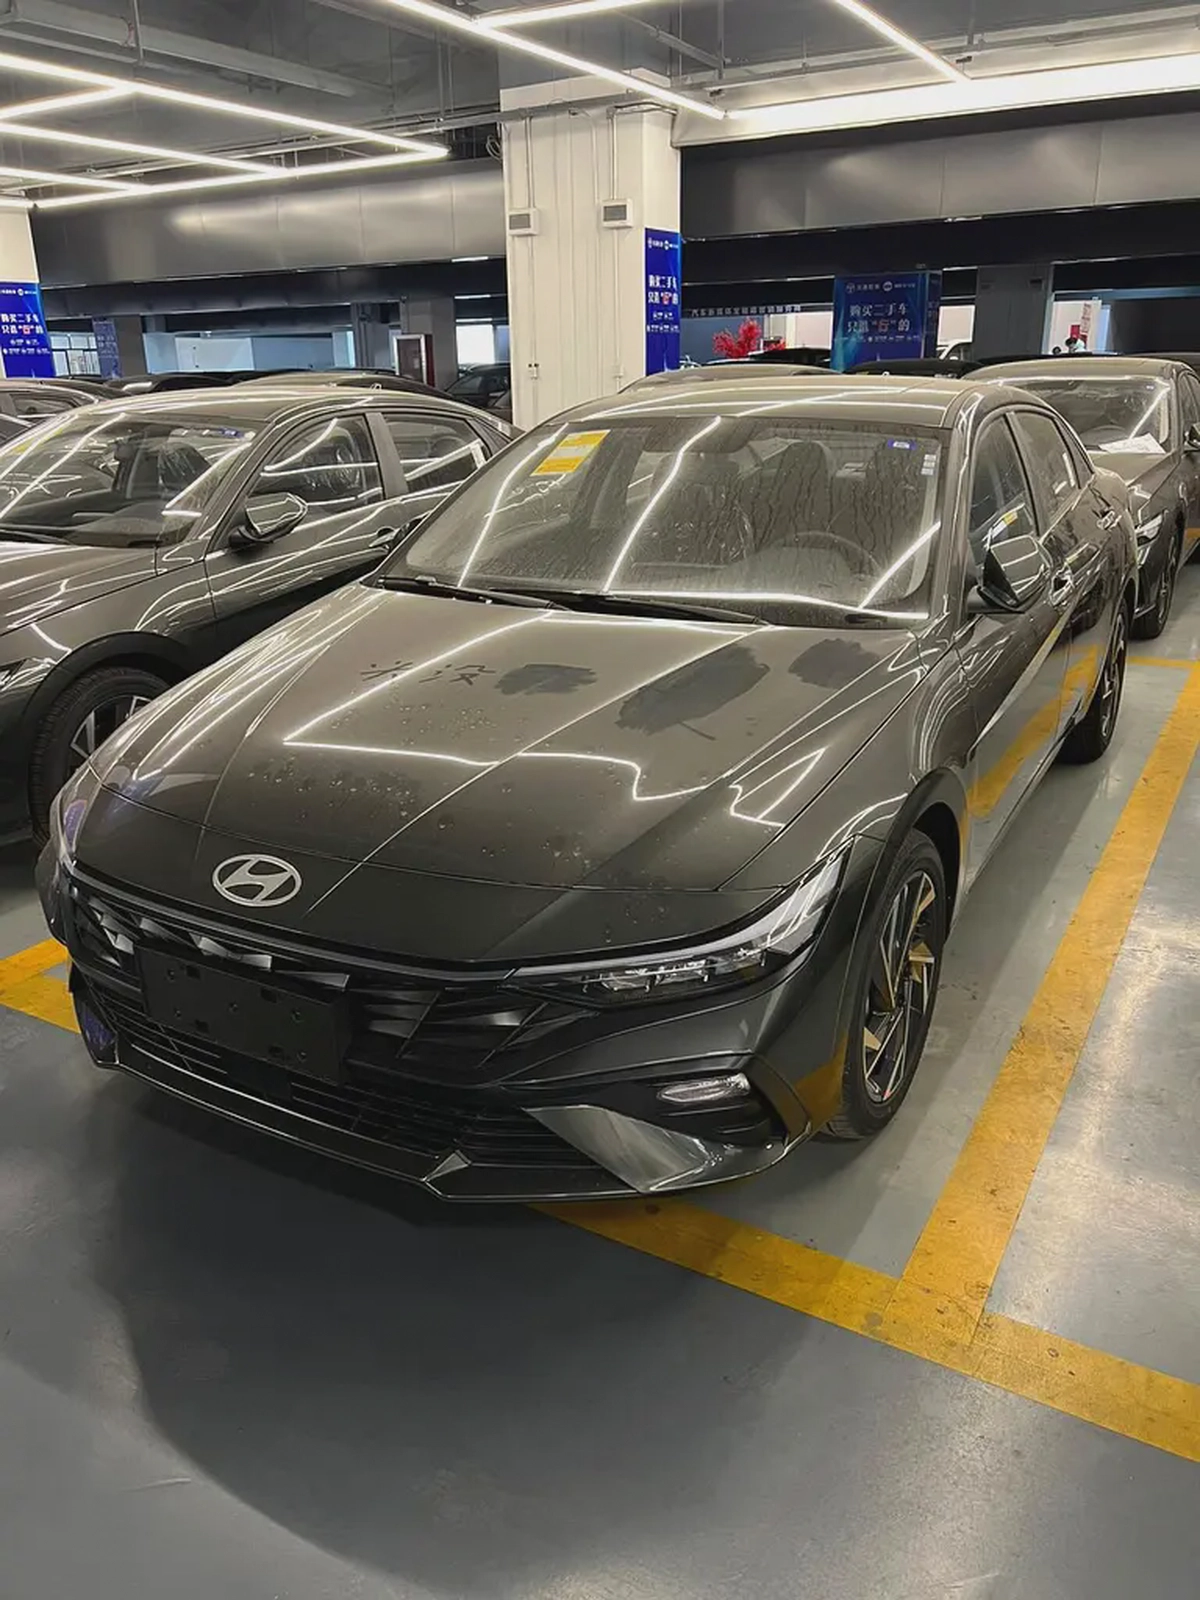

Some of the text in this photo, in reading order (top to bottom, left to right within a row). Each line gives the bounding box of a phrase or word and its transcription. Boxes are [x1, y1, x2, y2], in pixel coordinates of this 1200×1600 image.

[849, 302, 909, 317] 购买二手车
